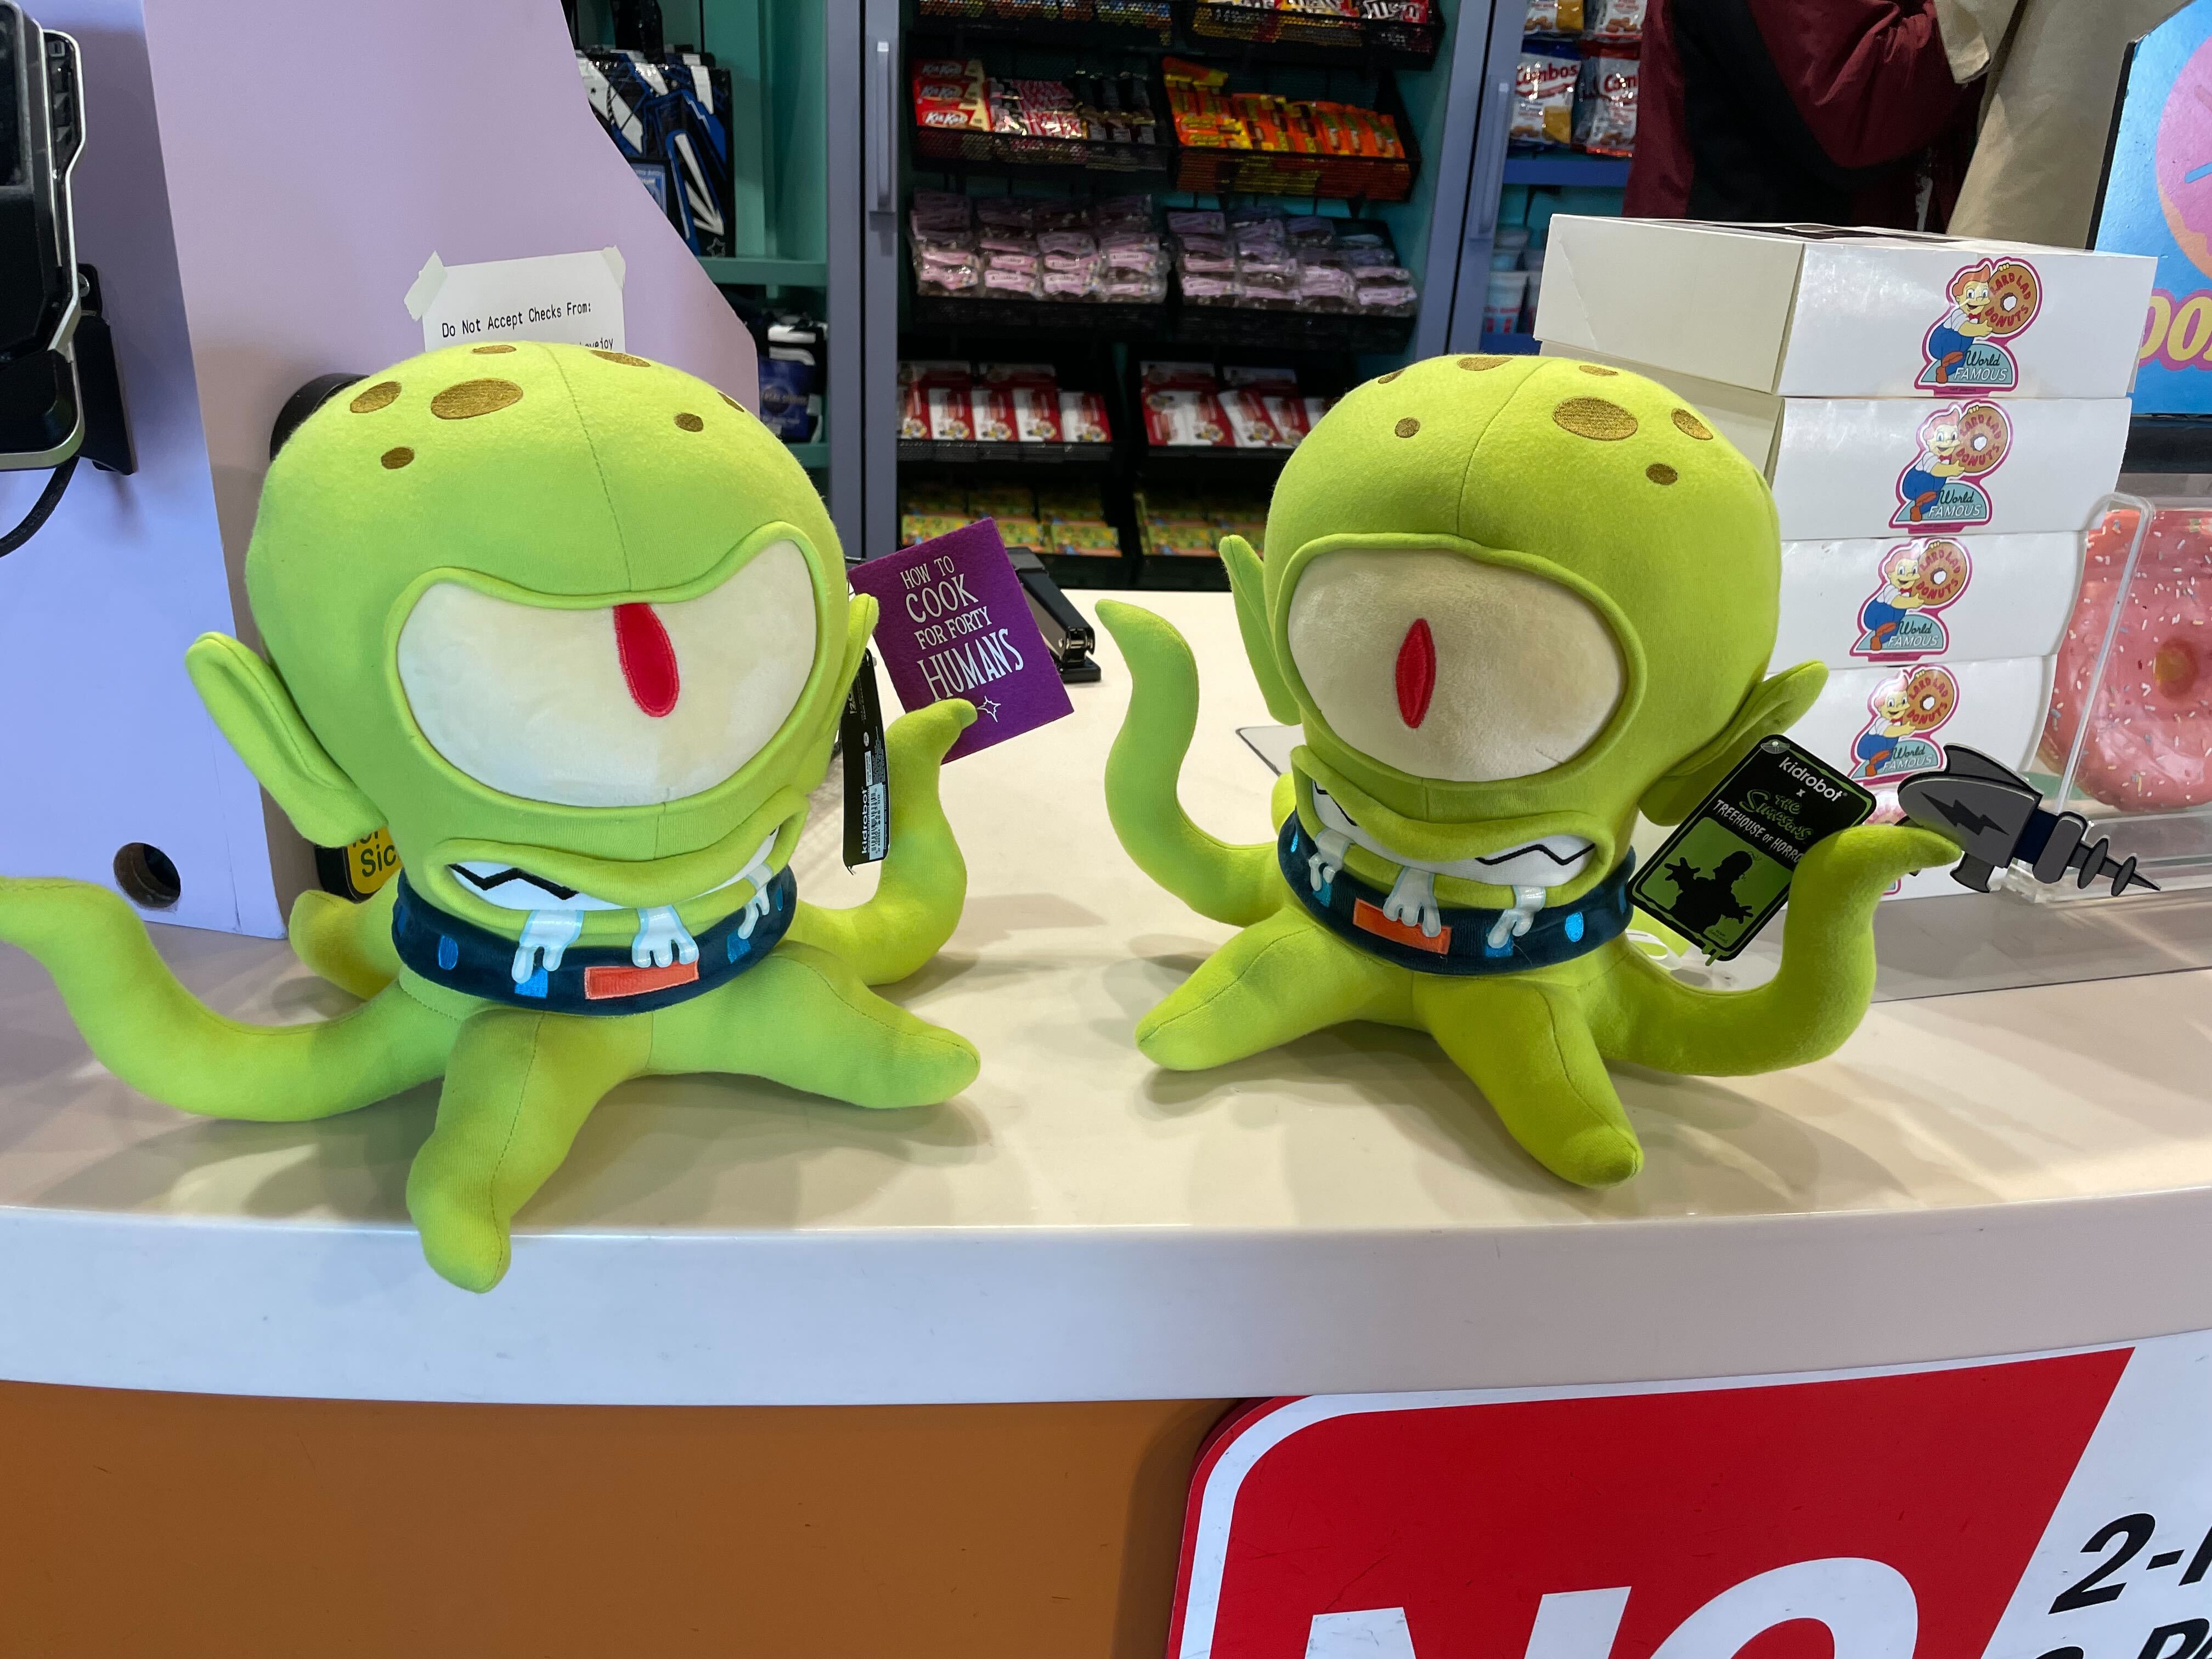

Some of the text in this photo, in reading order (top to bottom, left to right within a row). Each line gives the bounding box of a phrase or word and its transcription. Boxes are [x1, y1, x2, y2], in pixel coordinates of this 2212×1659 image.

[1990, 273, 2031, 300] LARD LAD
[442, 302, 591, 338] Do Not Accept Checks From:
[1985, 304, 2029, 327] DONUTS
[2140, 296, 2212, 362] DO
[579, 337, 613, 351] vejoy
[1965, 350, 2001, 366] World
[1954, 367, 2008, 381] FAMOUS
[1959, 414, 2002, 439] LARD LAD
[1956, 444, 2000, 466] DONUTS
[1938, 490, 1974, 504] World
[1928, 504, 1982, 518] FAMOUS
[900, 555, 955, 590] HOW TO
[1920, 550, 1961, 574] LARD LAD
[905, 573, 979, 623] COOK
[1916, 578, 1959, 600] DONUTS
[913, 606, 993, 650] FOR FORTY
[1898, 620, 1932, 635] World
[1887, 635, 1939, 647] FAMOUS
[917, 628, 1024, 702] HUMANS
[1906, 702, 1948, 724] DONUTS
[1882, 754, 1933, 771] FAMOUS
[1892, 744, 1926, 759] World
[1779, 757, 1843, 802] kidrobot
[1713, 799, 1766, 838] TREEHOUSE
[1762, 833, 1774, 843] OF
[360, 844, 400, 878] Sic
[2048, 1513, 2212, 1615] 2-
